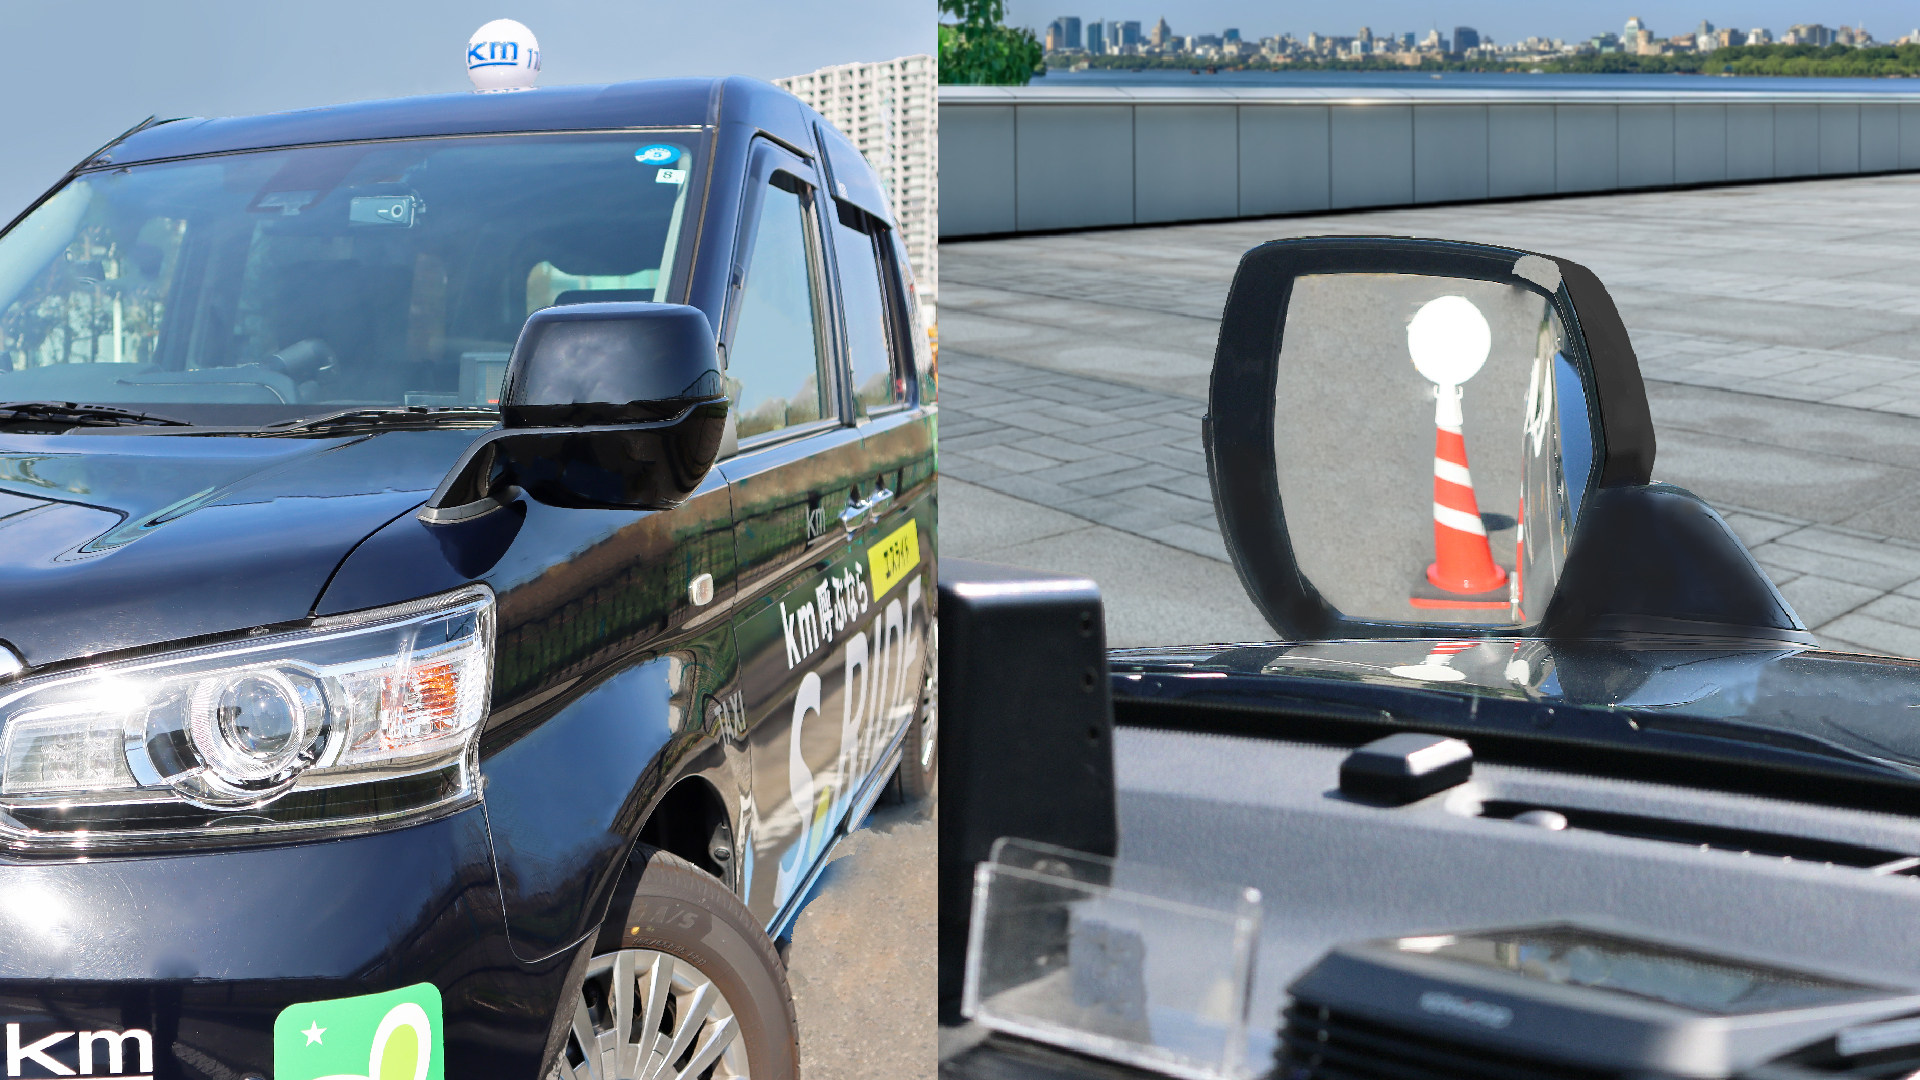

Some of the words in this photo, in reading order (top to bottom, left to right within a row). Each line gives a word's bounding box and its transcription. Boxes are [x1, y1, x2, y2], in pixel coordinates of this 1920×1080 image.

[468, 41, 518, 64] km
[806, 506, 826, 540] km
[714, 689, 746, 747] TAXI
[6, 1023, 154, 1077] km
